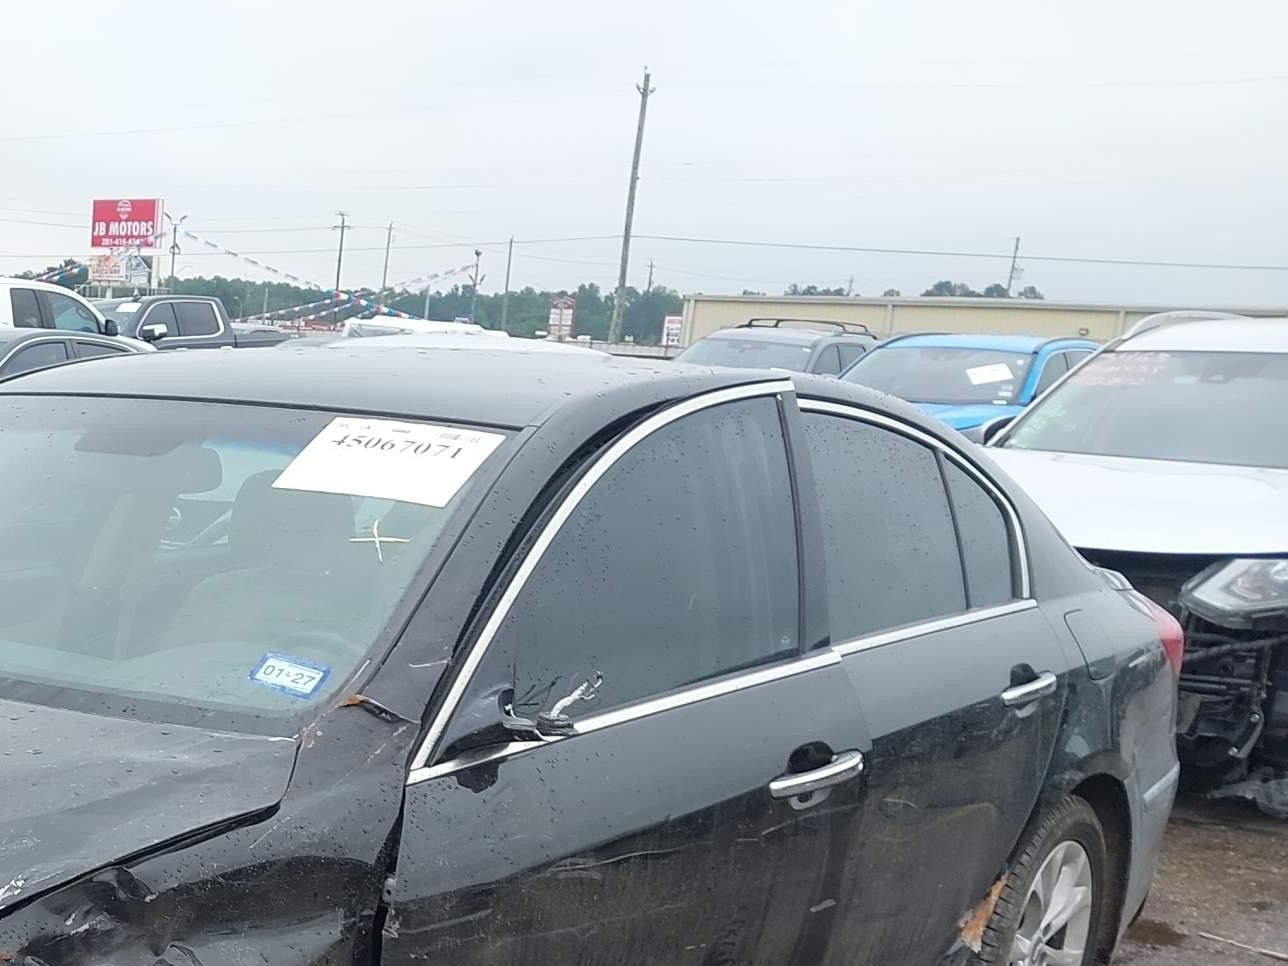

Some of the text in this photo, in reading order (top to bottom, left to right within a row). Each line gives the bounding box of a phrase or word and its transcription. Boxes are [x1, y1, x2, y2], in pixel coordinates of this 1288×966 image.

[94, 221, 153, 236] JB MOTORS
[330, 434, 463, 459] 45067071
